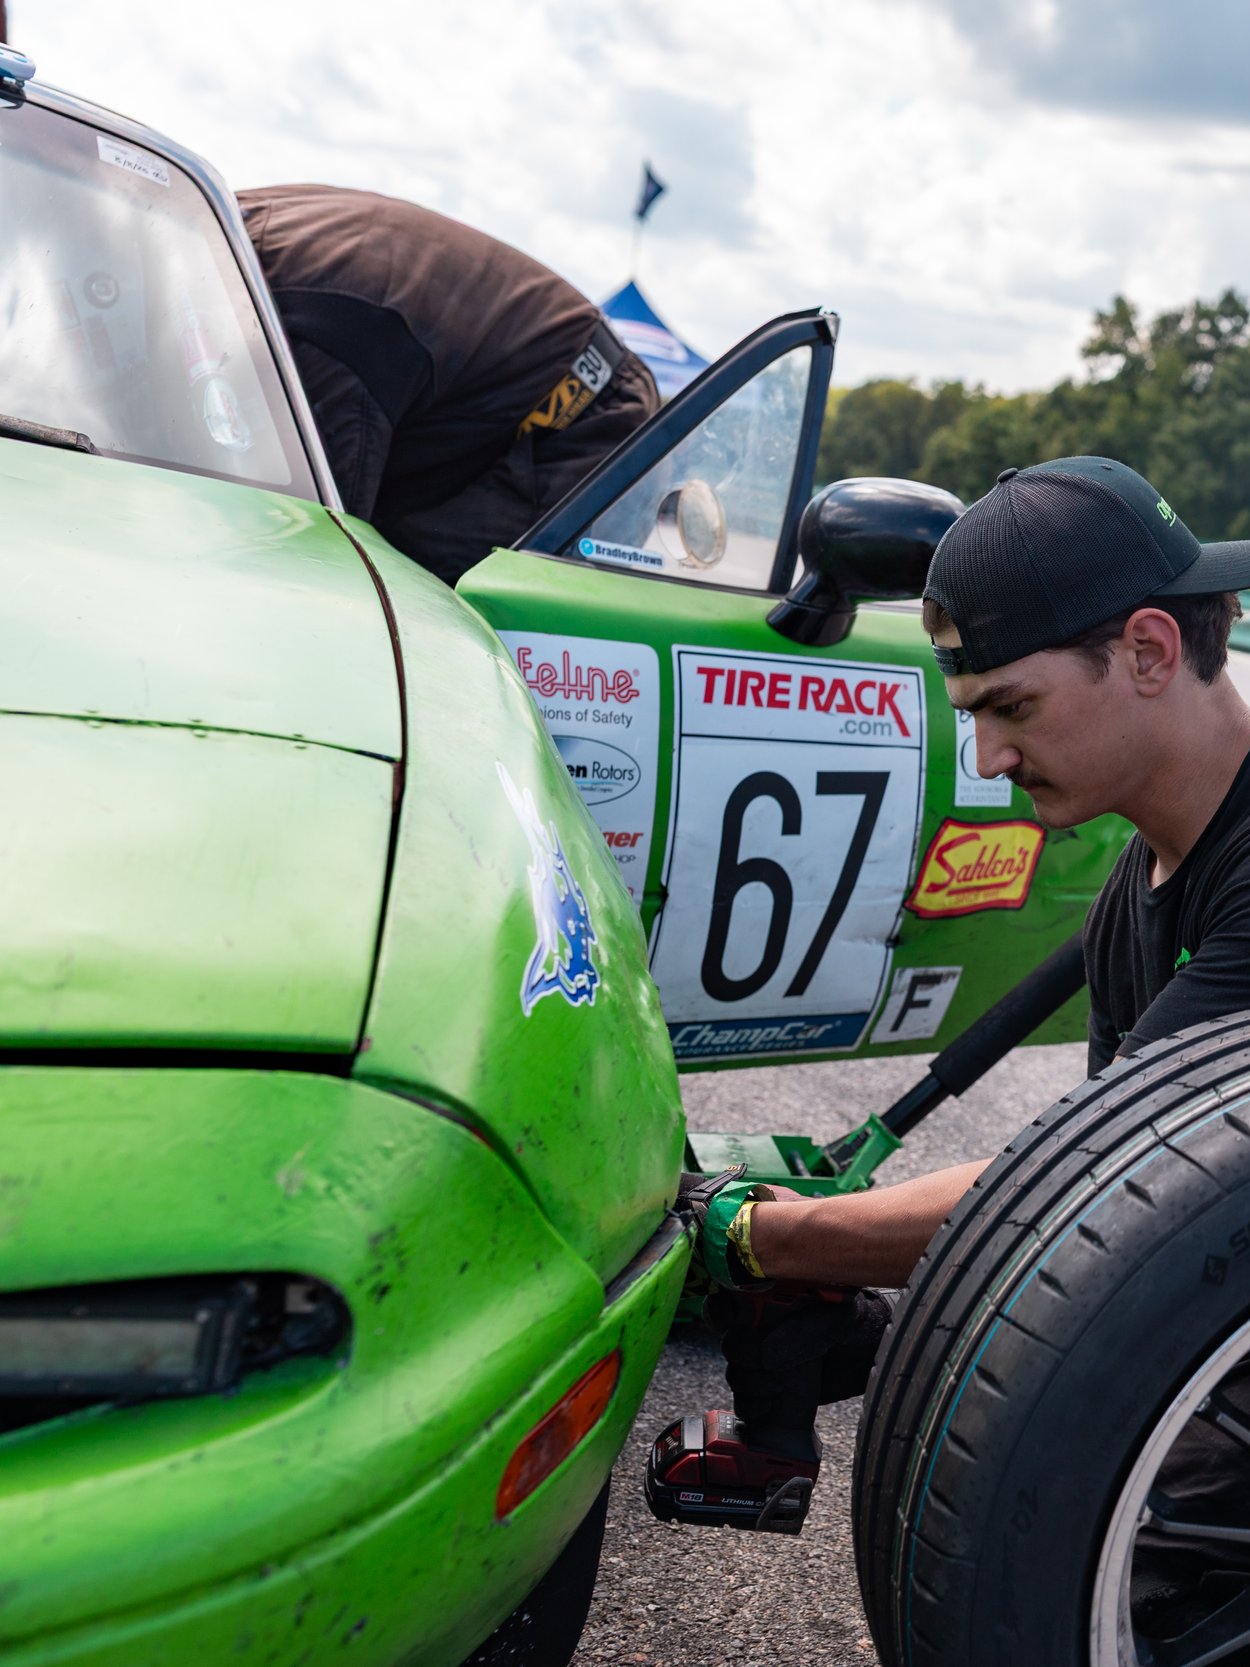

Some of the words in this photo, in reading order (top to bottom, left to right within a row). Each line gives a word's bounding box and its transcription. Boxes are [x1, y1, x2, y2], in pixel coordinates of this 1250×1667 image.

[595, 544, 663, 566] BradleyBrown
[518, 647, 640, 703] Feline
[697, 666, 792, 709] TIRE
[798, 675, 911, 738] RACK
[539, 705, 571, 721] ions
[575, 708, 588, 722] of
[592, 708, 633, 729] Safety
[839, 720, 893, 737] .com
[592, 761, 635, 781] Rotors
[925, 832, 1030, 893] Sahlen's
[701, 771, 891, 1003] 67
[889, 973, 944, 1033] F
[672, 1021, 832, 1050] ChampCar
[680, 1492, 703, 1502] M18
